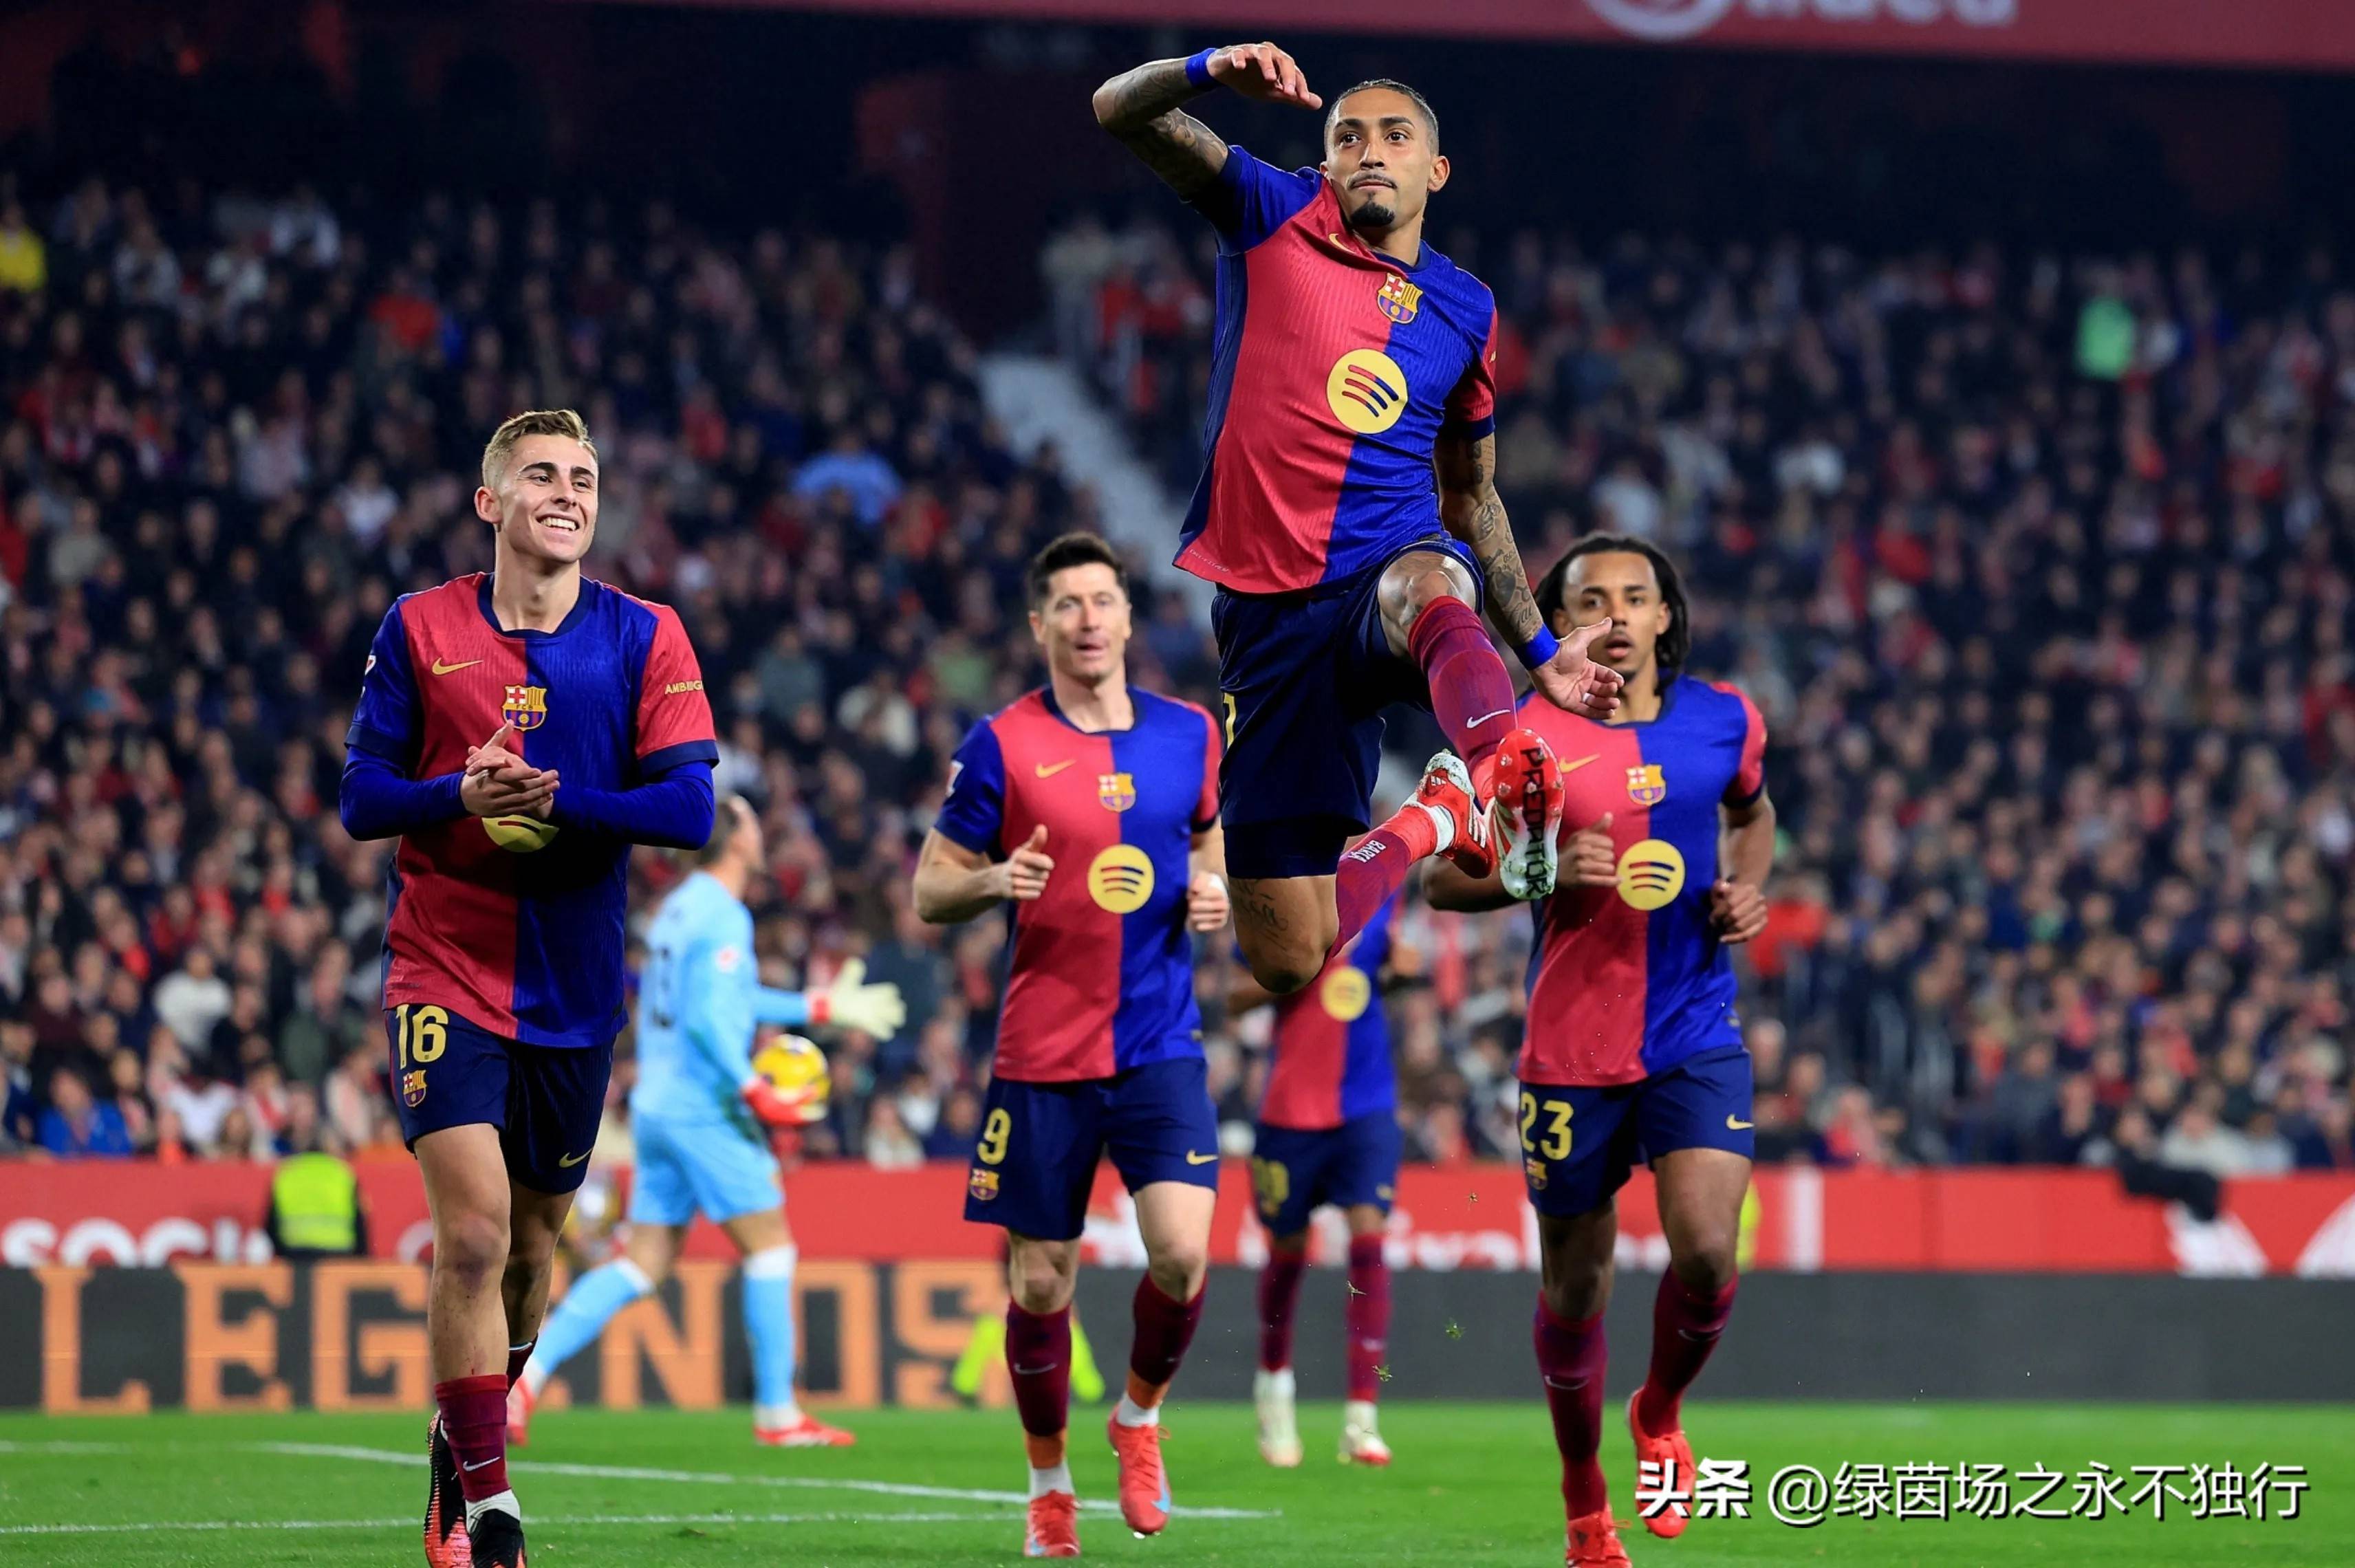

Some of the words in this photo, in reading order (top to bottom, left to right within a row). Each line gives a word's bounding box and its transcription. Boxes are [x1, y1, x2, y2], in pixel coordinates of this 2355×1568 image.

[395, 1003, 448, 1070] 16
[977, 1107, 1012, 1165] 9
[1520, 1091, 1574, 1161] 23
[30, 1260, 1015, 1413] LEGNDS
